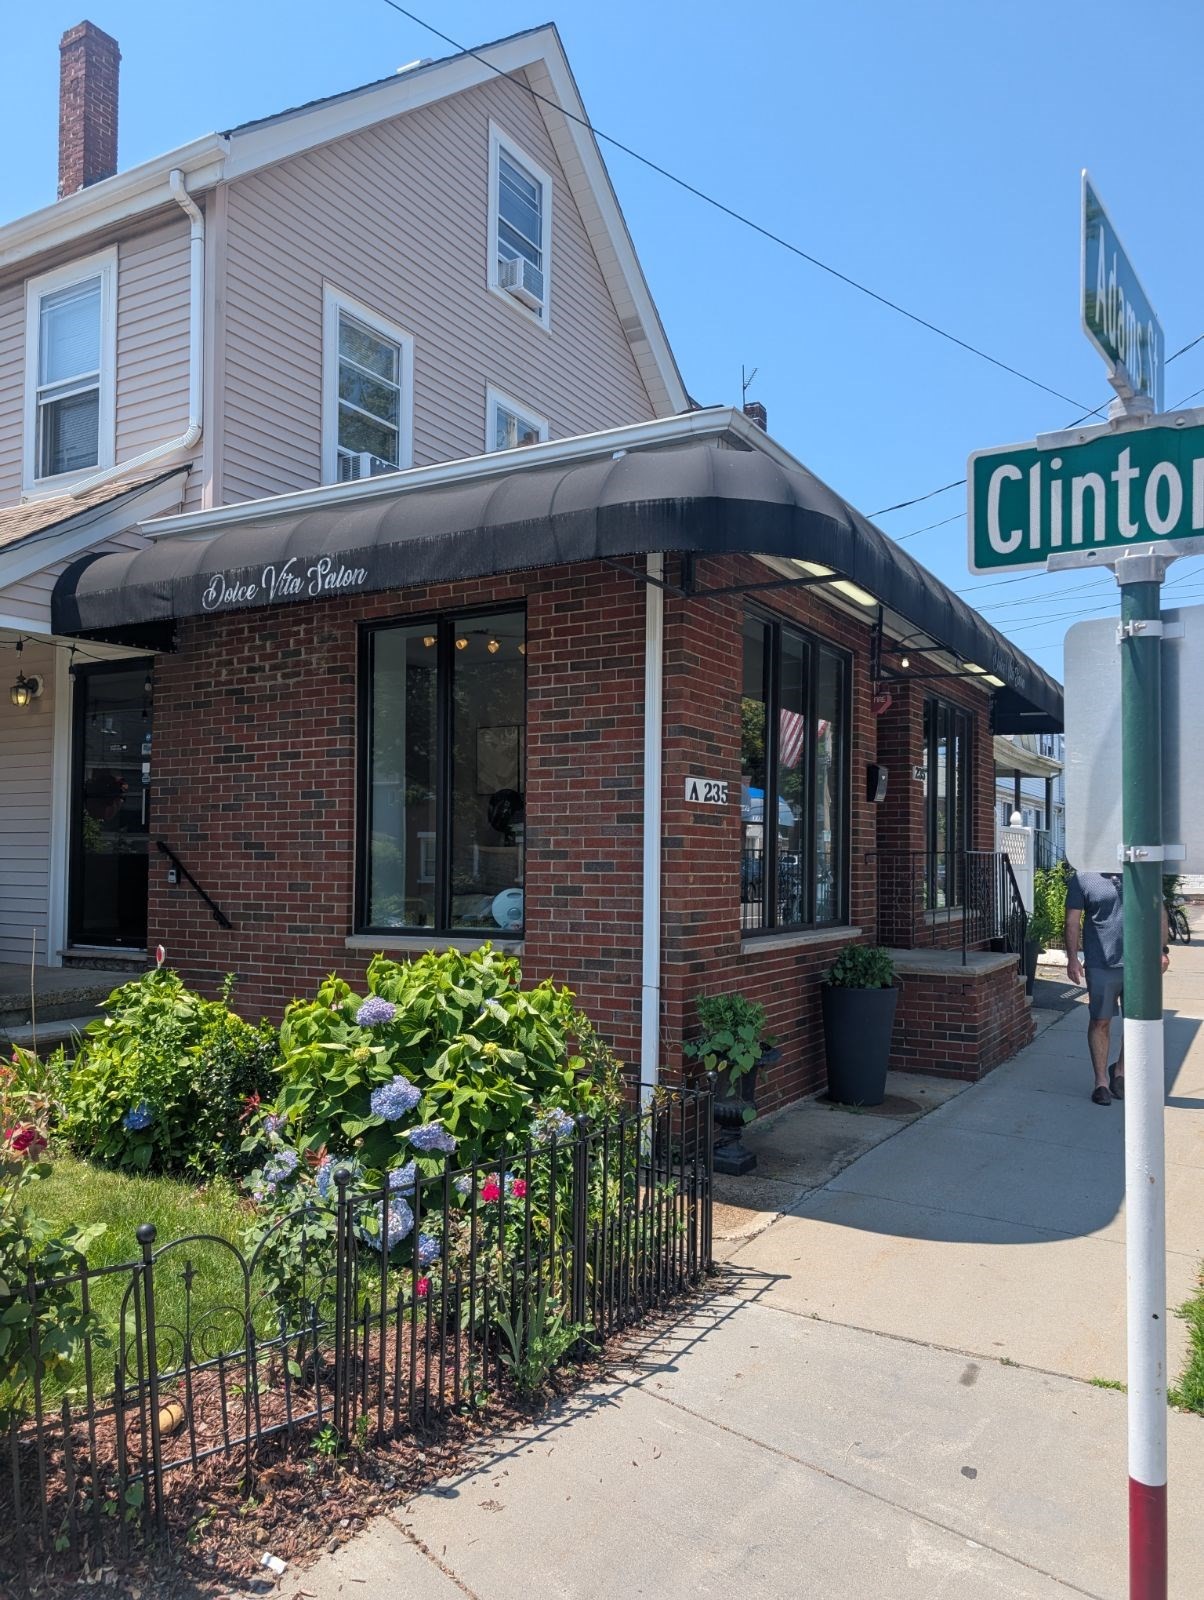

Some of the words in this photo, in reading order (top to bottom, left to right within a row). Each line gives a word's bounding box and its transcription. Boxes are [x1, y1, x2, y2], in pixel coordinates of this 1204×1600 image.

[1095, 224, 1143, 390] Adams
[1147, 319, 1159, 414] St
[202, 573, 259, 610] Dolce
[261, 557, 304, 600] Vita
[307, 557, 368, 596] Salon
[689, 781, 700, 801] A
[703, 782, 728, 804] 235
